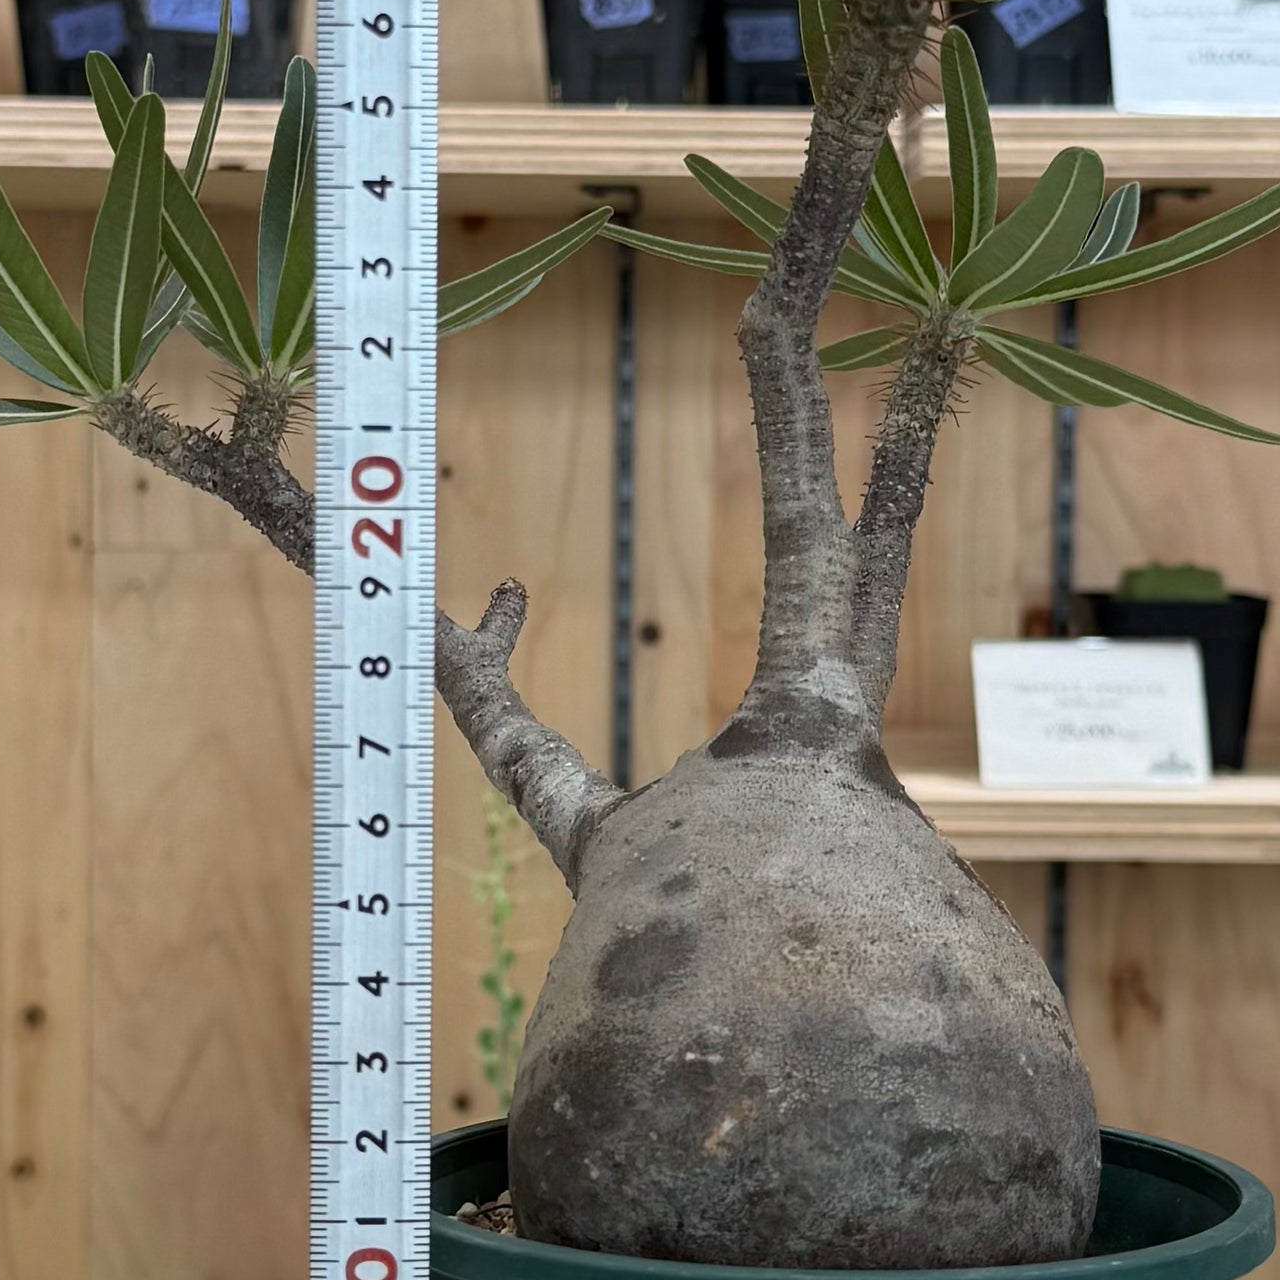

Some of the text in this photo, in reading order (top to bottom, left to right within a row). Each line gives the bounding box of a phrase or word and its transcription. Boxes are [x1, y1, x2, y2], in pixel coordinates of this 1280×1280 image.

[362, 12, 394, 38] 6
[361, 95, 394, 118] 5
[362, 175, 394, 201] 4
[361, 257, 393, 278] 3
[361, 336, 392, 360] 2
[351, 455, 403, 558] 20
[359, 576, 391, 599] 9
[359, 655, 392, 679] 8
[358, 735, 391, 759] 7
[358, 813, 390, 838] 6
[357, 893, 390, 916] 5
[357, 970, 390, 997] 4
[356, 1051, 388, 1074] 3
[355, 1129, 388, 1153] 2
[354, 1217, 387, 1226] 1
